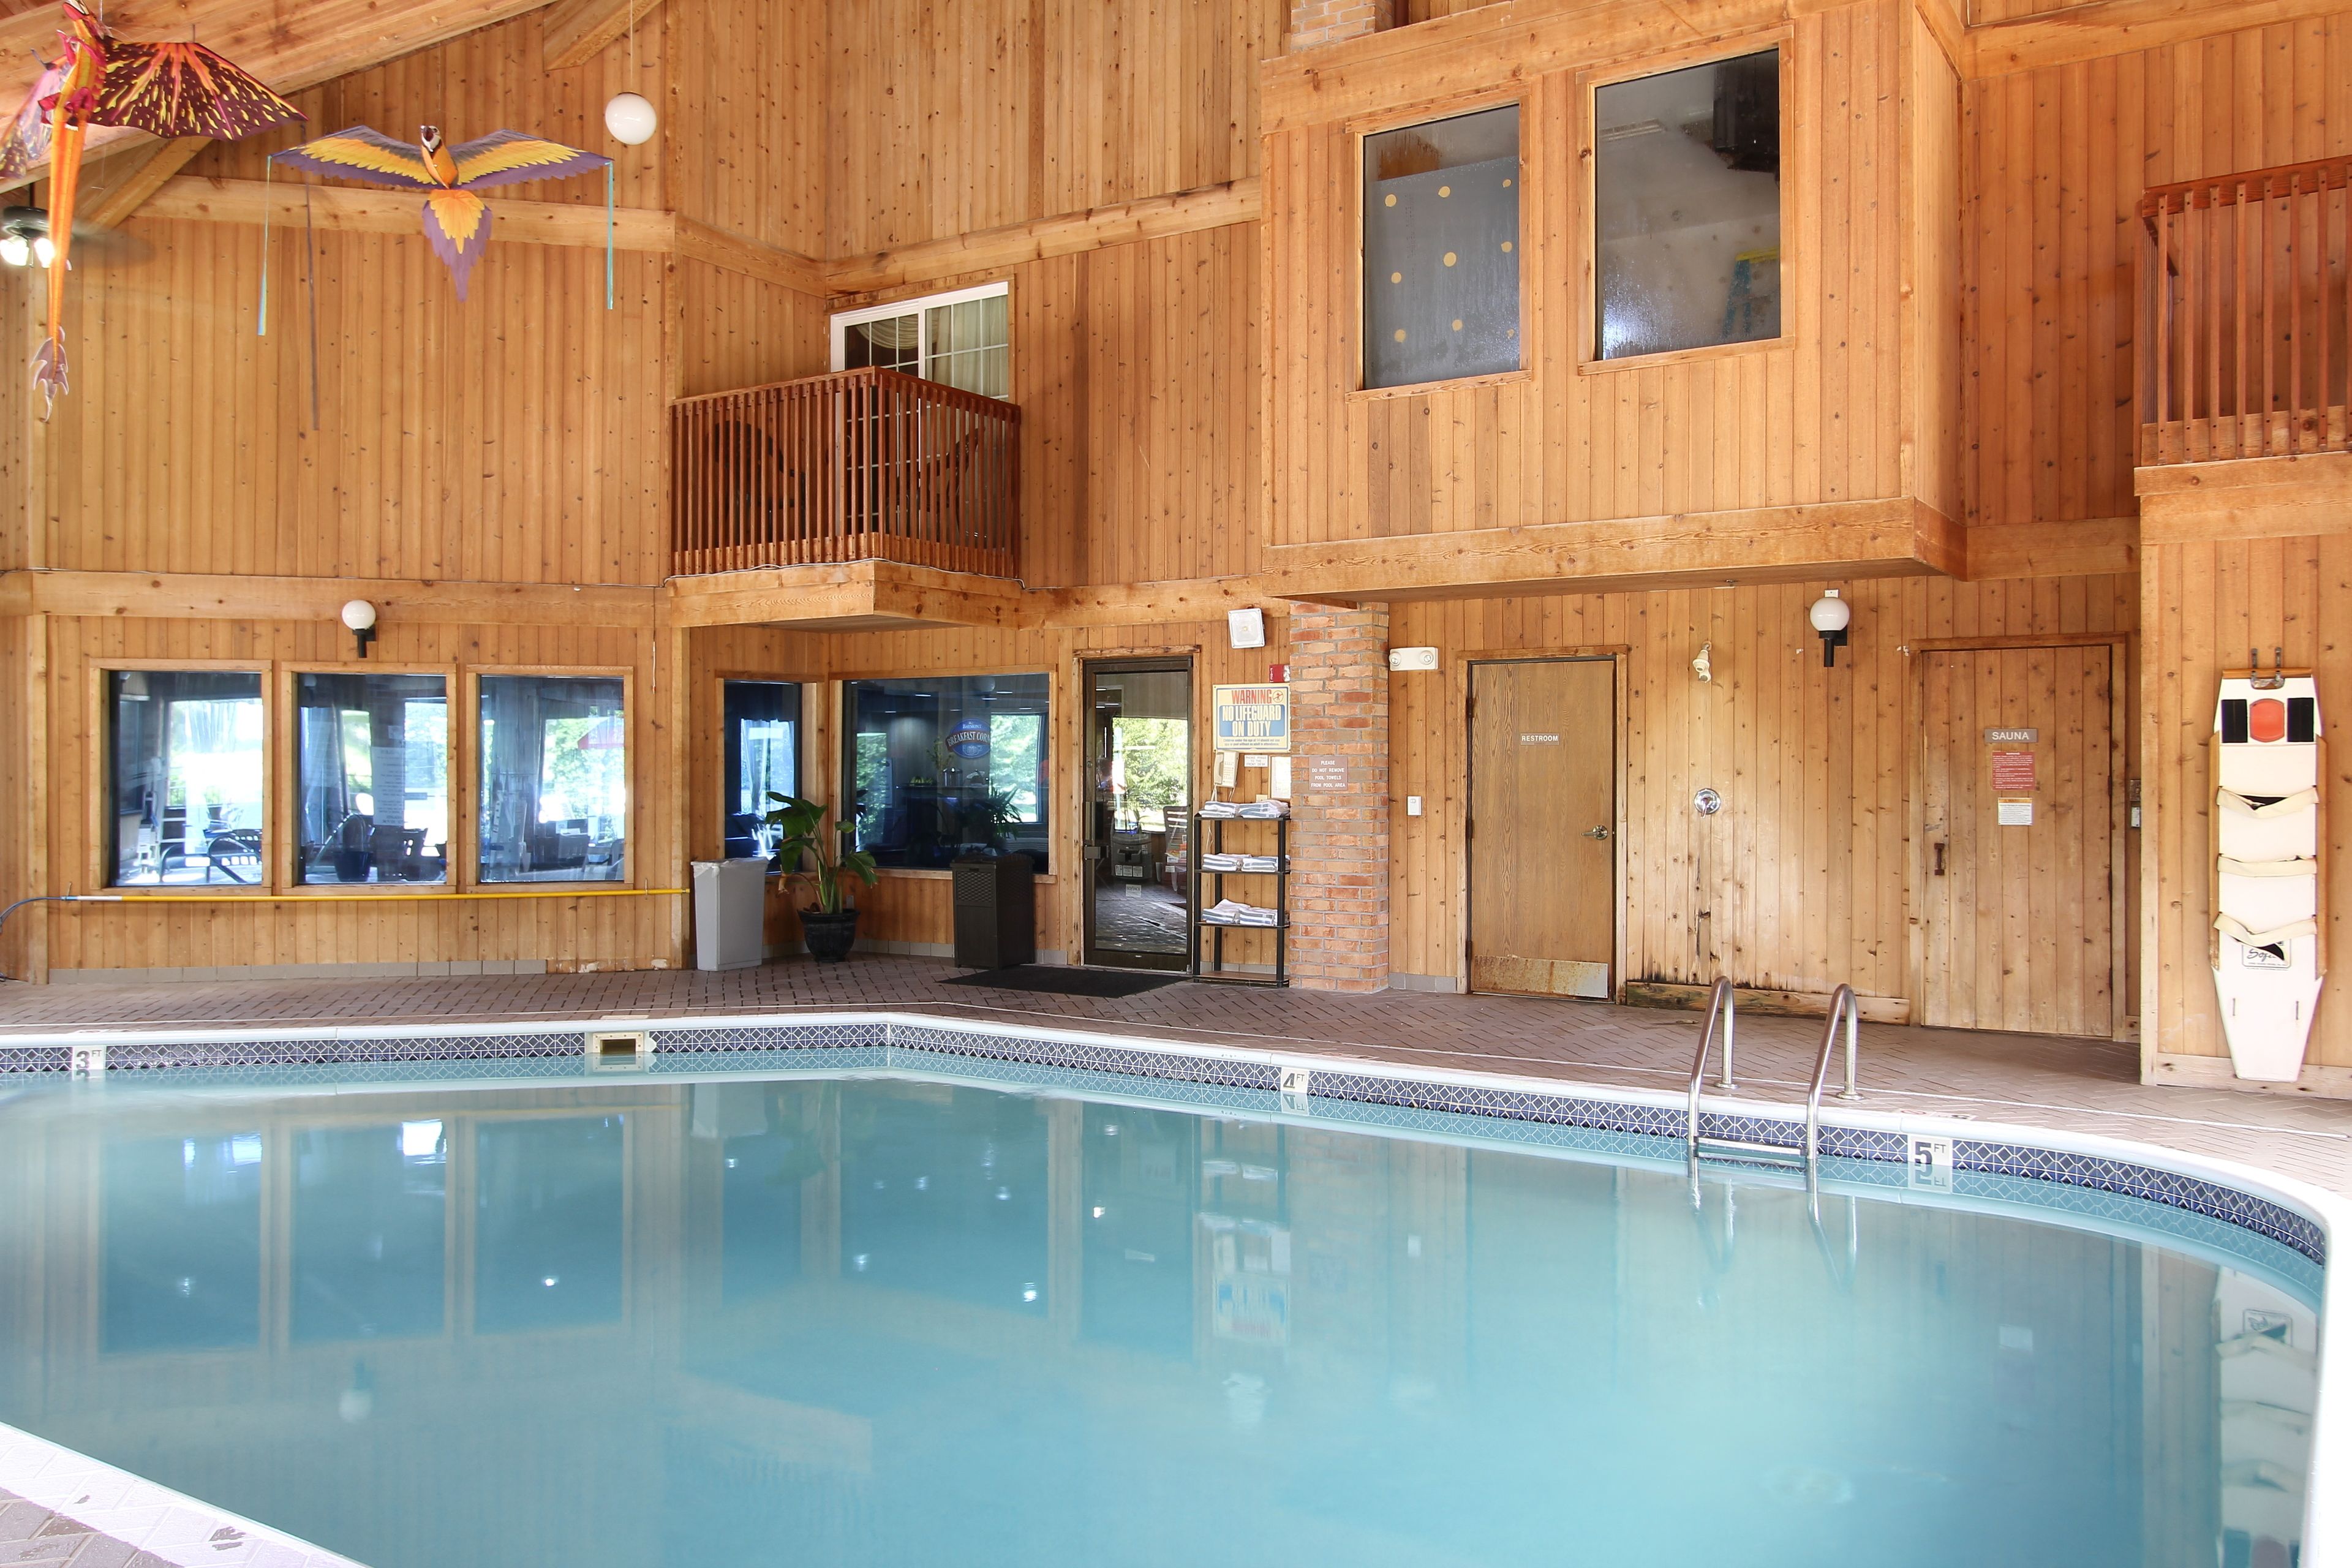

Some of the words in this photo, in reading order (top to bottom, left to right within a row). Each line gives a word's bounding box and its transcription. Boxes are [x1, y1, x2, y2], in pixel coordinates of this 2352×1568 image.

[1232, 689, 1272, 704] WARNING
[1223, 706, 1234, 722] NO
[1235, 705, 1281, 721] LIFEGUARD
[1232, 721, 1244, 736] ON
[1247, 721, 1271, 736] DUTY
[1992, 731, 2029, 740] SAUNA
[947, 731, 976, 747] BREAKFAST
[1915, 1141, 1932, 1165] 5
